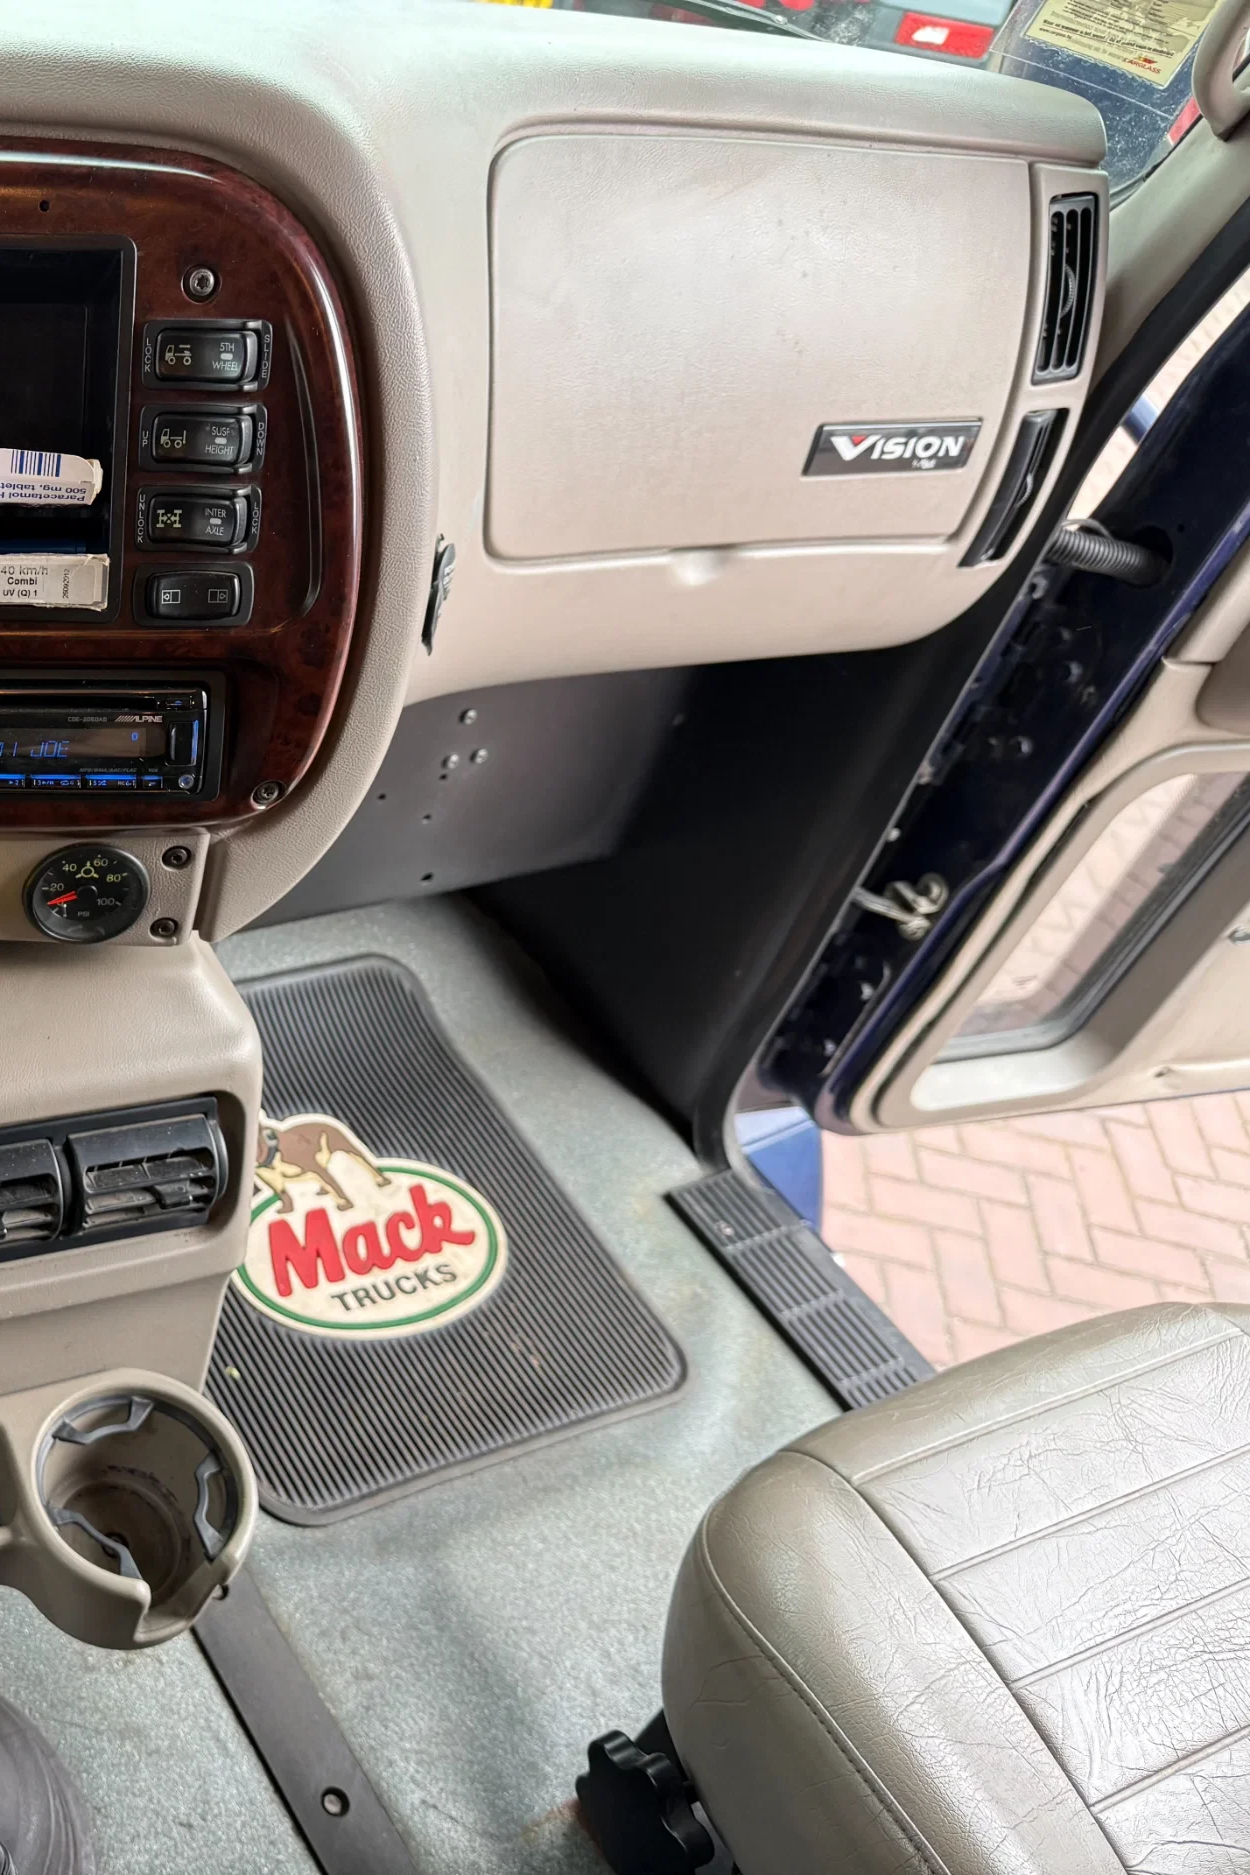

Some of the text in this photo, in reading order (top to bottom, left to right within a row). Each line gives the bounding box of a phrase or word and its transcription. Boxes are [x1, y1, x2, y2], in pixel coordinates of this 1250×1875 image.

[219, 343, 235, 352] 5TH
[144, 338, 152, 372] LOCK
[261, 335, 271, 379] SLIDE
[212, 360, 239, 371] WHEEL
[142, 431, 149, 447] UP
[256, 422, 265, 456] DOWN
[205, 445, 234, 455] HEIGHT
[830, 434, 965, 461] VISION
[8, 492, 86, 502] Paracetamol
[205, 508, 227, 518] INTER
[137, 494, 146, 543] UNLOCK
[205, 526, 225, 536] AXLE
[19, 566, 48, 576] km/h
[7, 577, 38, 586] Combi
[3, 589, 15, 597] UV
[30, 740, 70, 758] JOE
[93, 858, 108, 867] 60
[62, 864, 77, 872] 40
[106, 874, 121, 882] 80
[50, 883, 64, 892] 20
[96, 898, 115, 906] 100
[268, 1184, 475, 1298] Mack
[331, 1264, 457, 1312] TRUCKS
